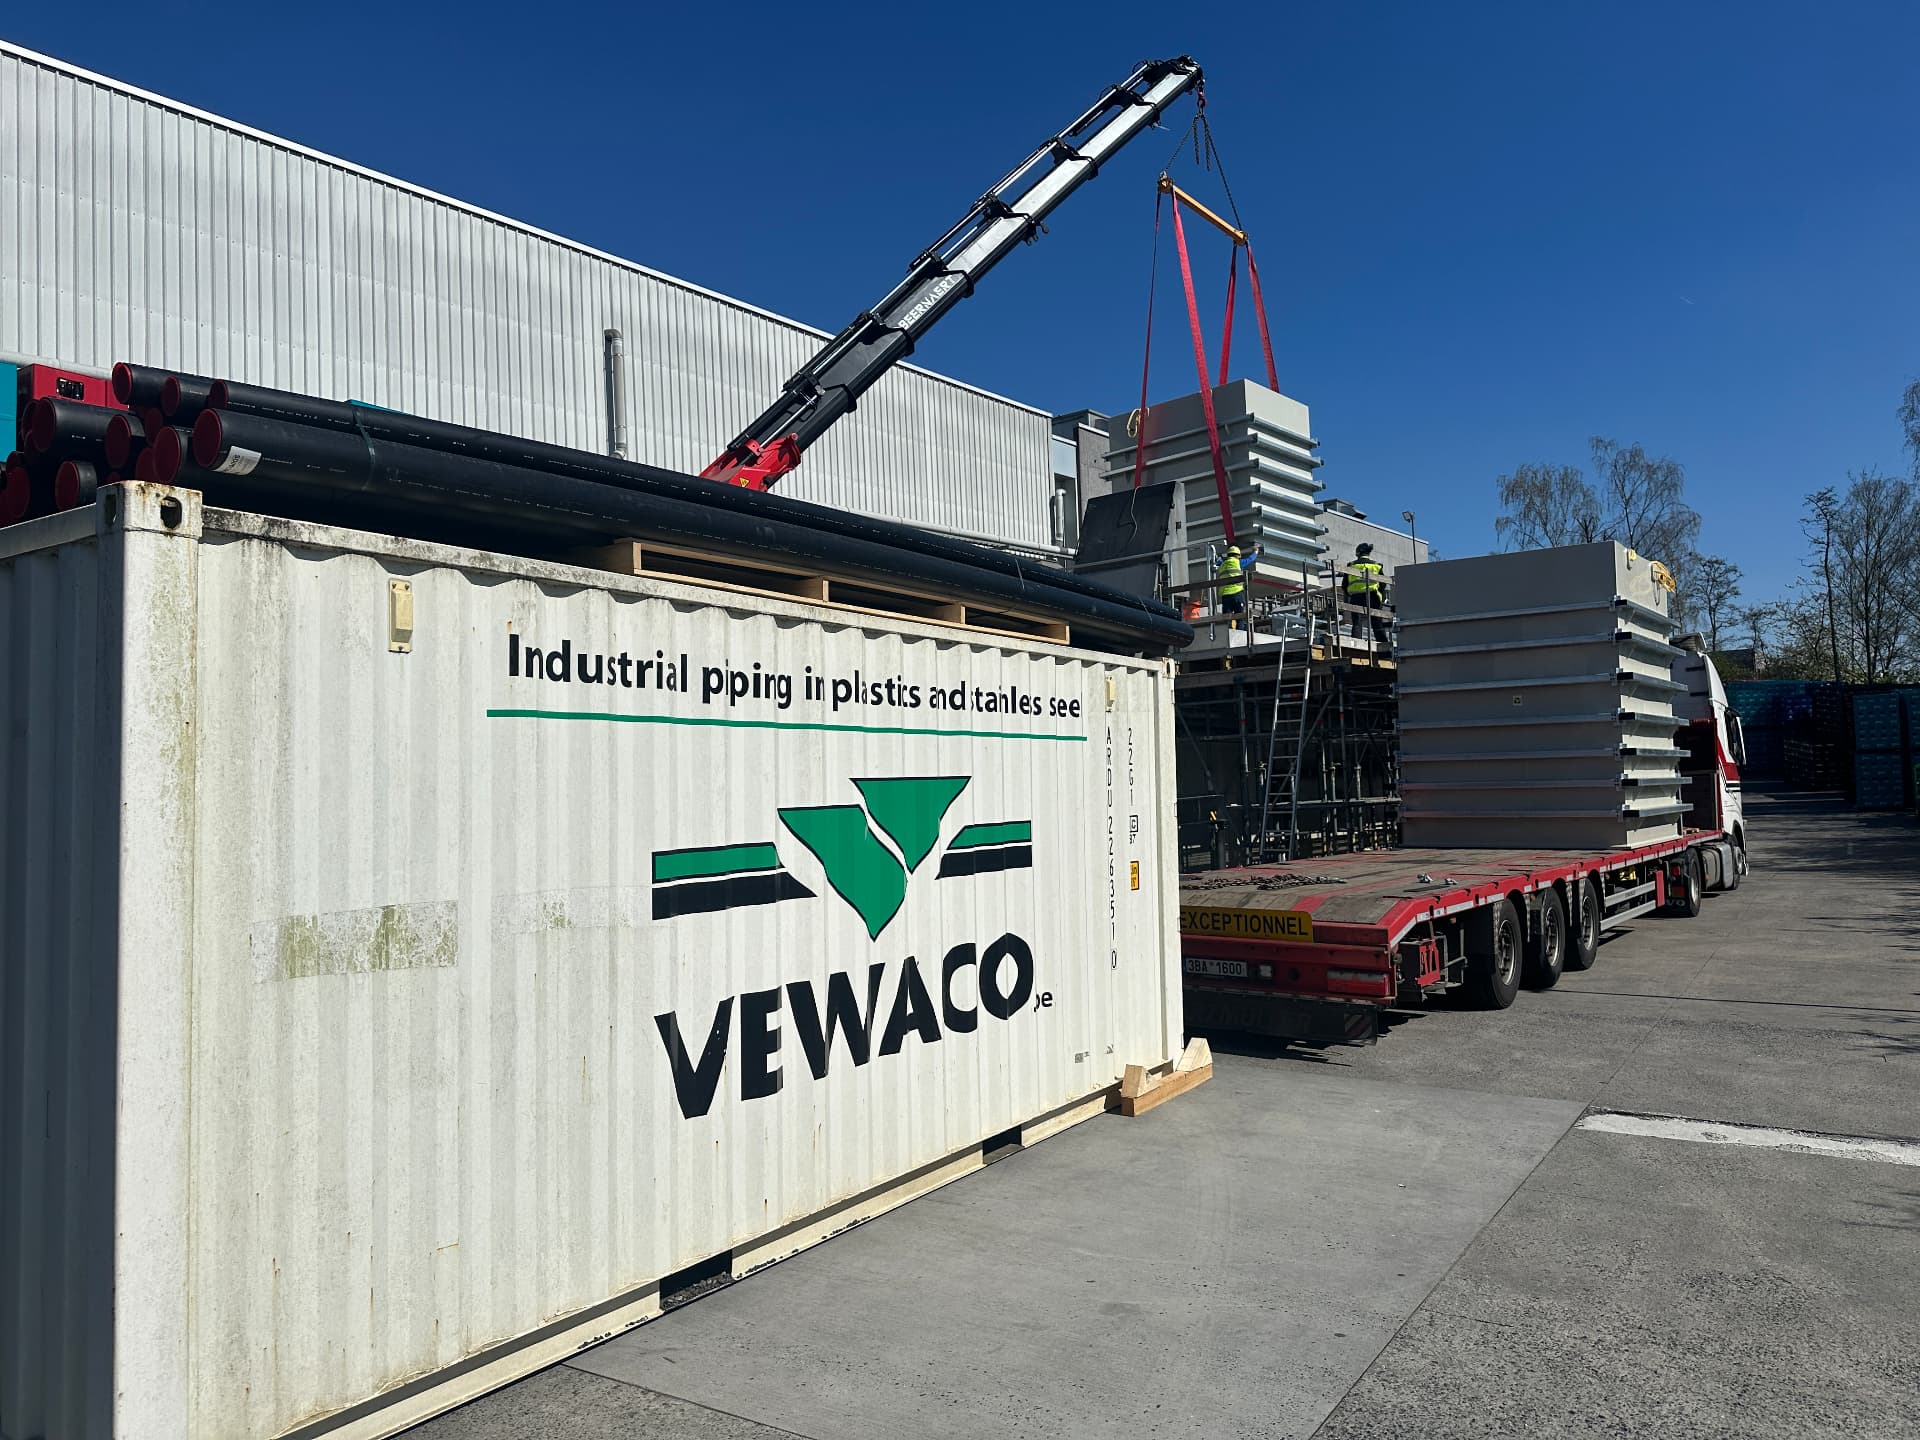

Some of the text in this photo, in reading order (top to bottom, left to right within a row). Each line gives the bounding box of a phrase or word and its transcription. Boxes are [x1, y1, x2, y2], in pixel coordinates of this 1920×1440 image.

[508, 633, 688, 693] Industrial
[702, 658, 792, 710] piping
[805, 665, 825, 702] in
[831, 669, 921, 712] plastics
[929, 680, 966, 711] and
[1180, 911, 1308, 935] EXCEPTIONNEL
[1216, 962, 1242, 975] 1600
[653, 932, 1035, 1120] VEWACO
